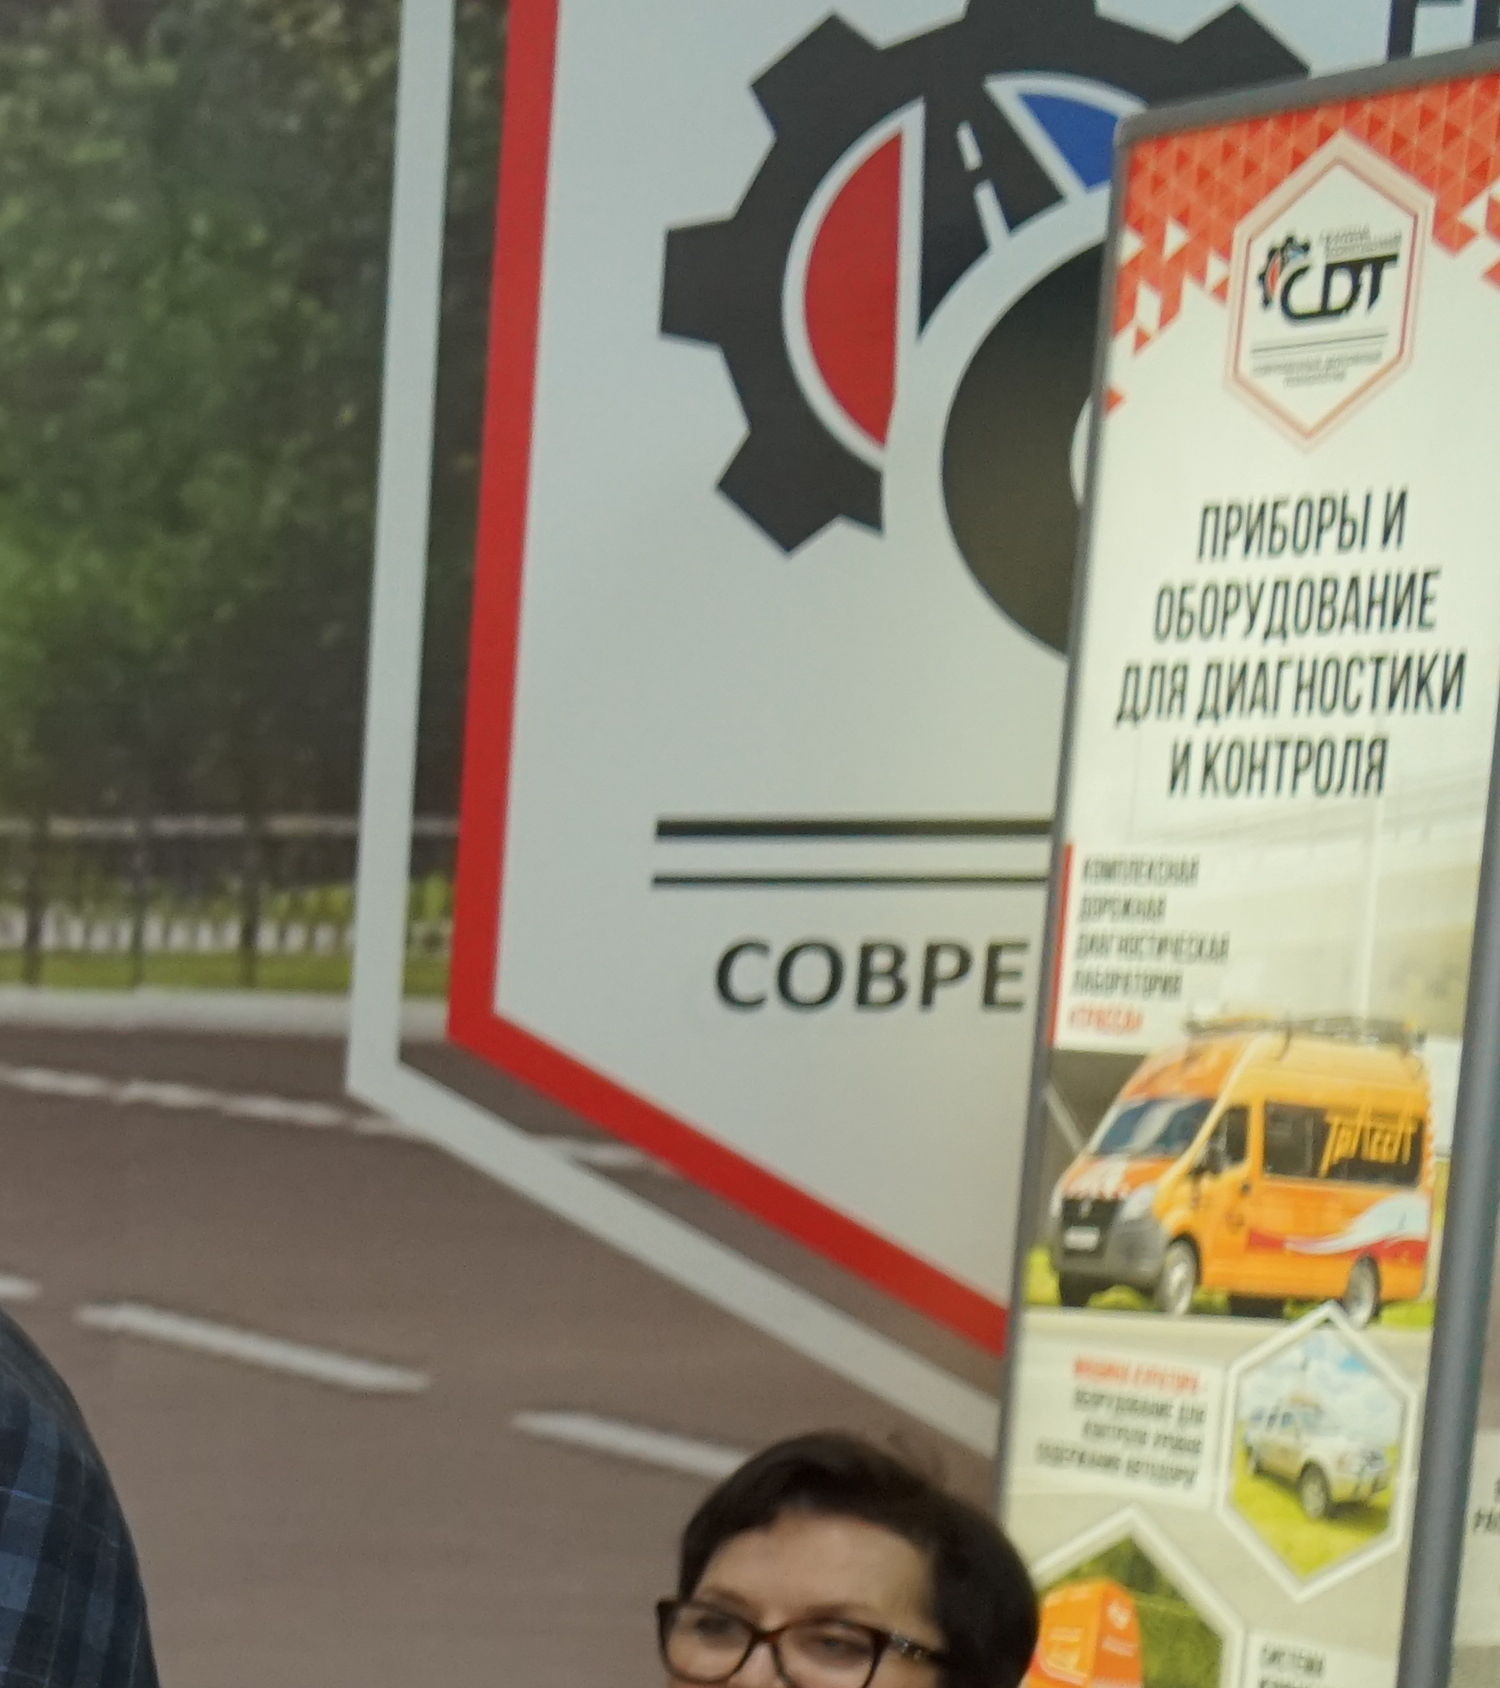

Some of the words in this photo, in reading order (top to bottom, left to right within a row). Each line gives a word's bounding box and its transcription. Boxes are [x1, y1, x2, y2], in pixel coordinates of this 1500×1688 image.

[1197, 489, 1371, 563] ПРИБОРЫ
[1383, 488, 1406, 551] И
[1154, 568, 1441, 644] ОБОРУДОВАНИЕ
[1116, 659, 1188, 726] ДЛЯ
[1195, 651, 1467, 726] ДИАГНОСТИКИ
[1168, 738, 1191, 799] И
[1201, 736, 1388, 797] КОНТРОЛЯ
[714, 937, 1029, 1011] СОВРЕ
